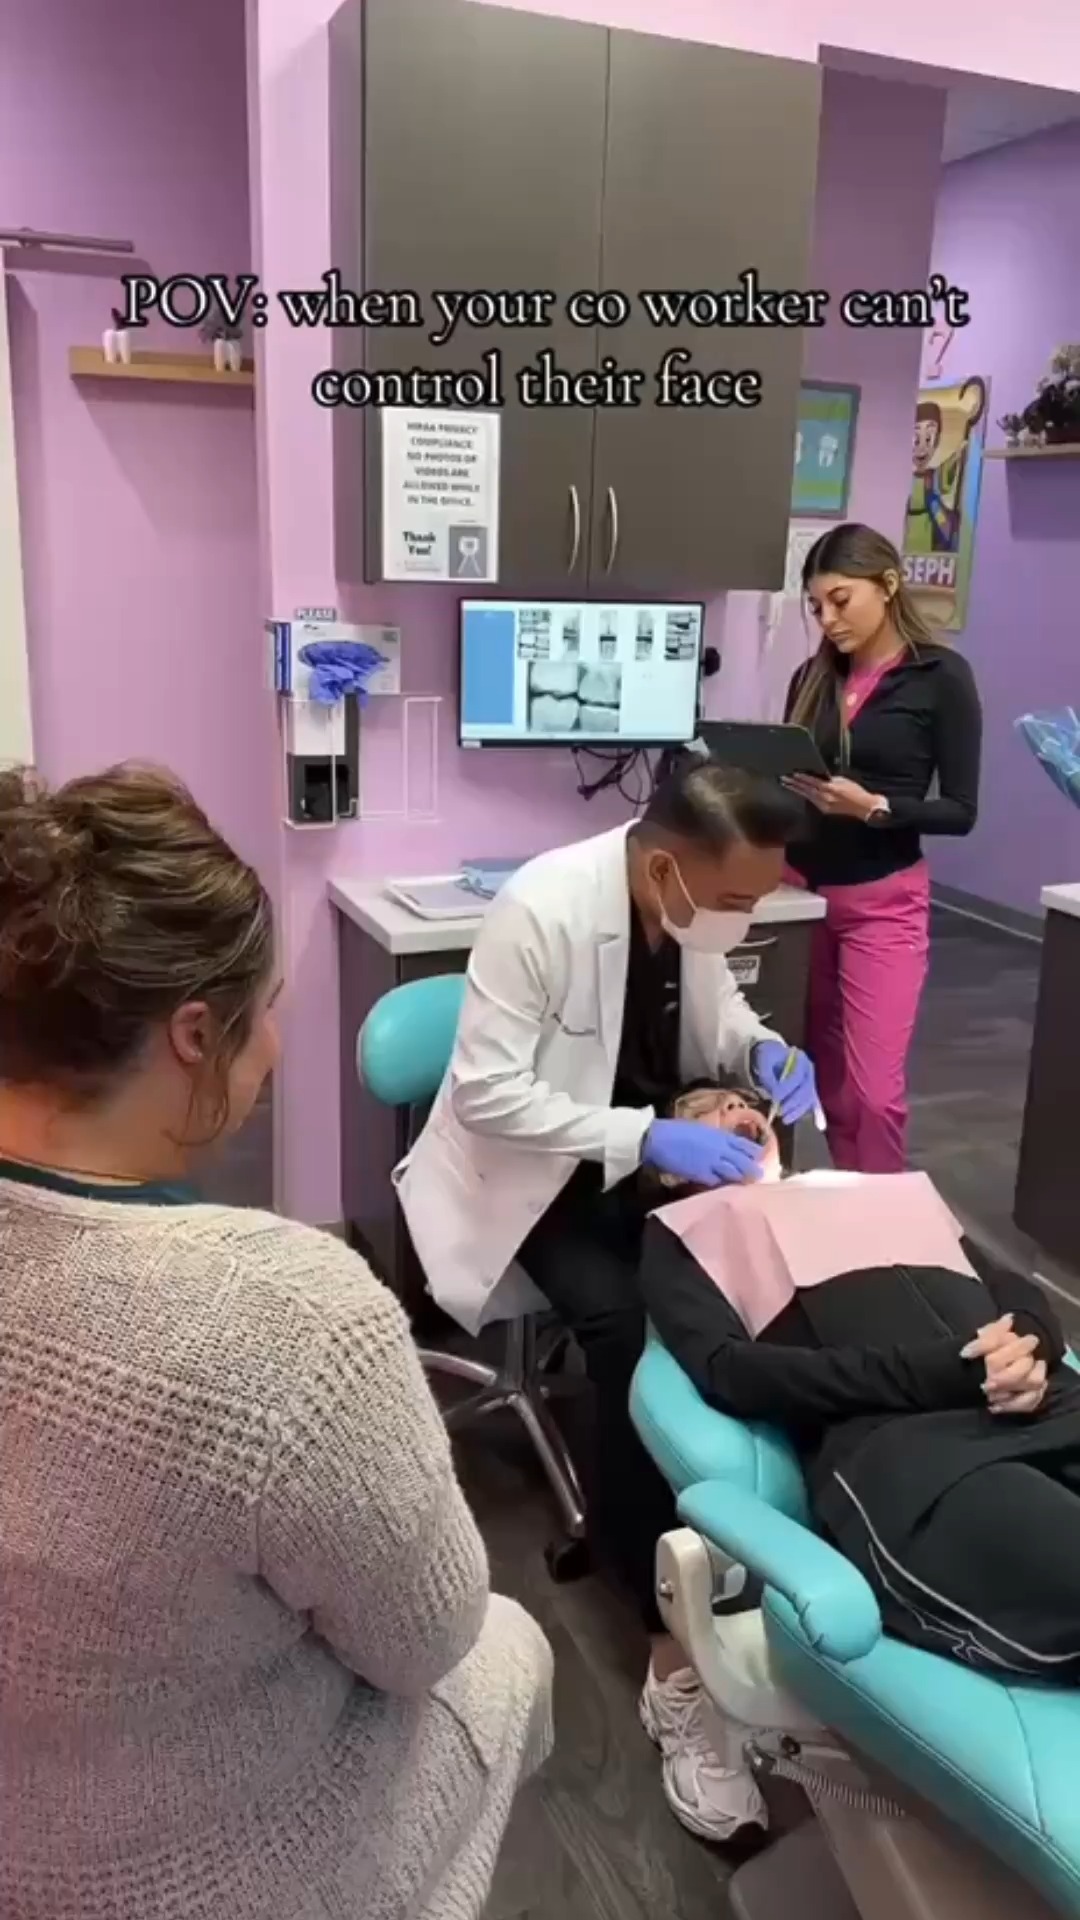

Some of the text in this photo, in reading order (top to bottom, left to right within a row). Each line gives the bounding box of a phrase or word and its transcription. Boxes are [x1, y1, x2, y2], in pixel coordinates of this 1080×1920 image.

[439, 423, 478, 433] PRIVACY
[407, 452, 477, 463] NO PHOTOS OR
[414, 466, 469, 477] VIDEOS ARE
[402, 480, 480, 492] ALLOWED WHILE
[407, 495, 419, 504] IN
[420, 496, 438, 505] THE
[402, 531, 436, 542] Thank
[408, 544, 432, 555] You!
[902, 557, 956, 585] SEPH
